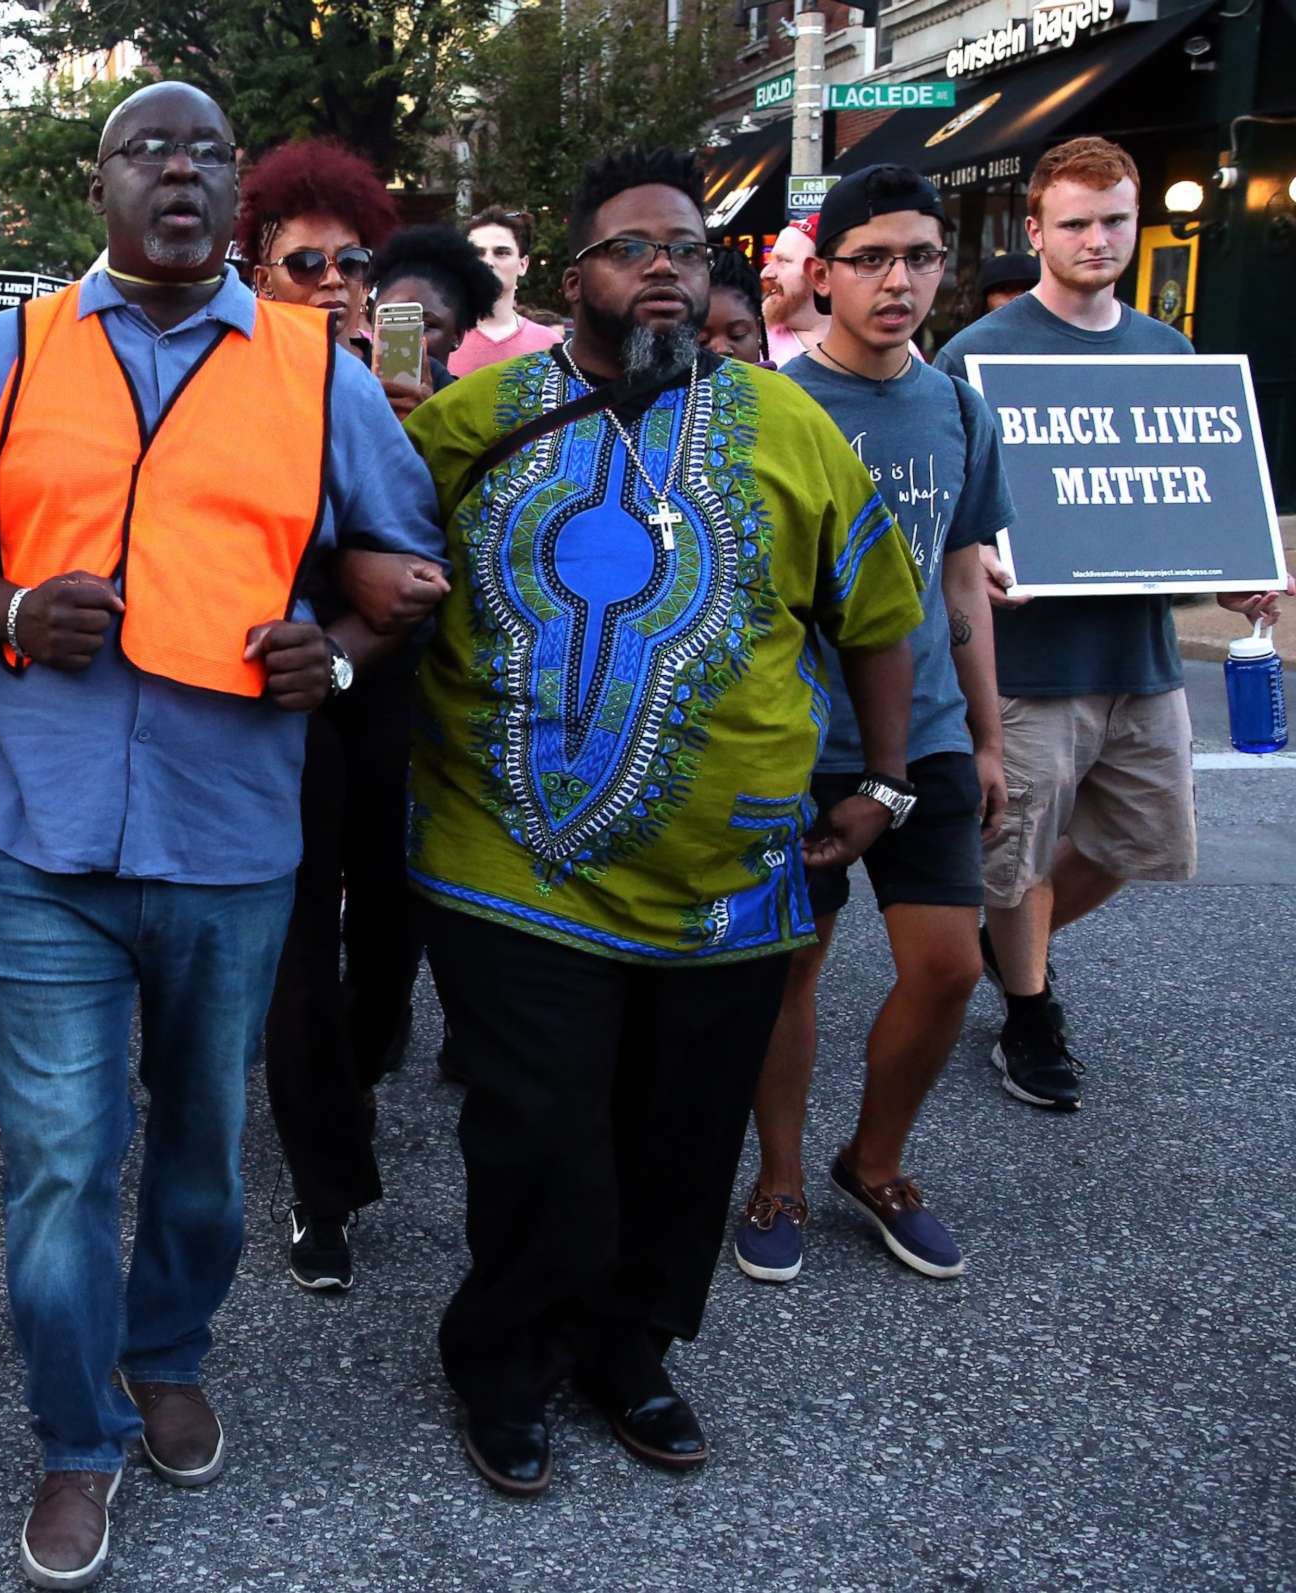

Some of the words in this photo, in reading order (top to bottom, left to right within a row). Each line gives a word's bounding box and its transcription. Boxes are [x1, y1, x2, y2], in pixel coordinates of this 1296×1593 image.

[1033, 0, 1114, 48] bagels
[756, 77, 792, 108] EUCLID
[831, 85, 934, 108] LACLEDE
[803, 179, 826, 191] real
[951, 165, 978, 187] LUNCH
[988, 156, 1021, 179] BAGELS
[4, 282, 33, 294] LIVES
[997, 406, 1121, 445] BLACK
[1130, 405, 1243, 444] LIVES
[850, 431, 882, 481] Tis
[891, 463, 904, 480] is
[898, 453, 939, 518] what
[943, 489, 950, 500] a
[1052, 466, 1212, 505] MATTER
